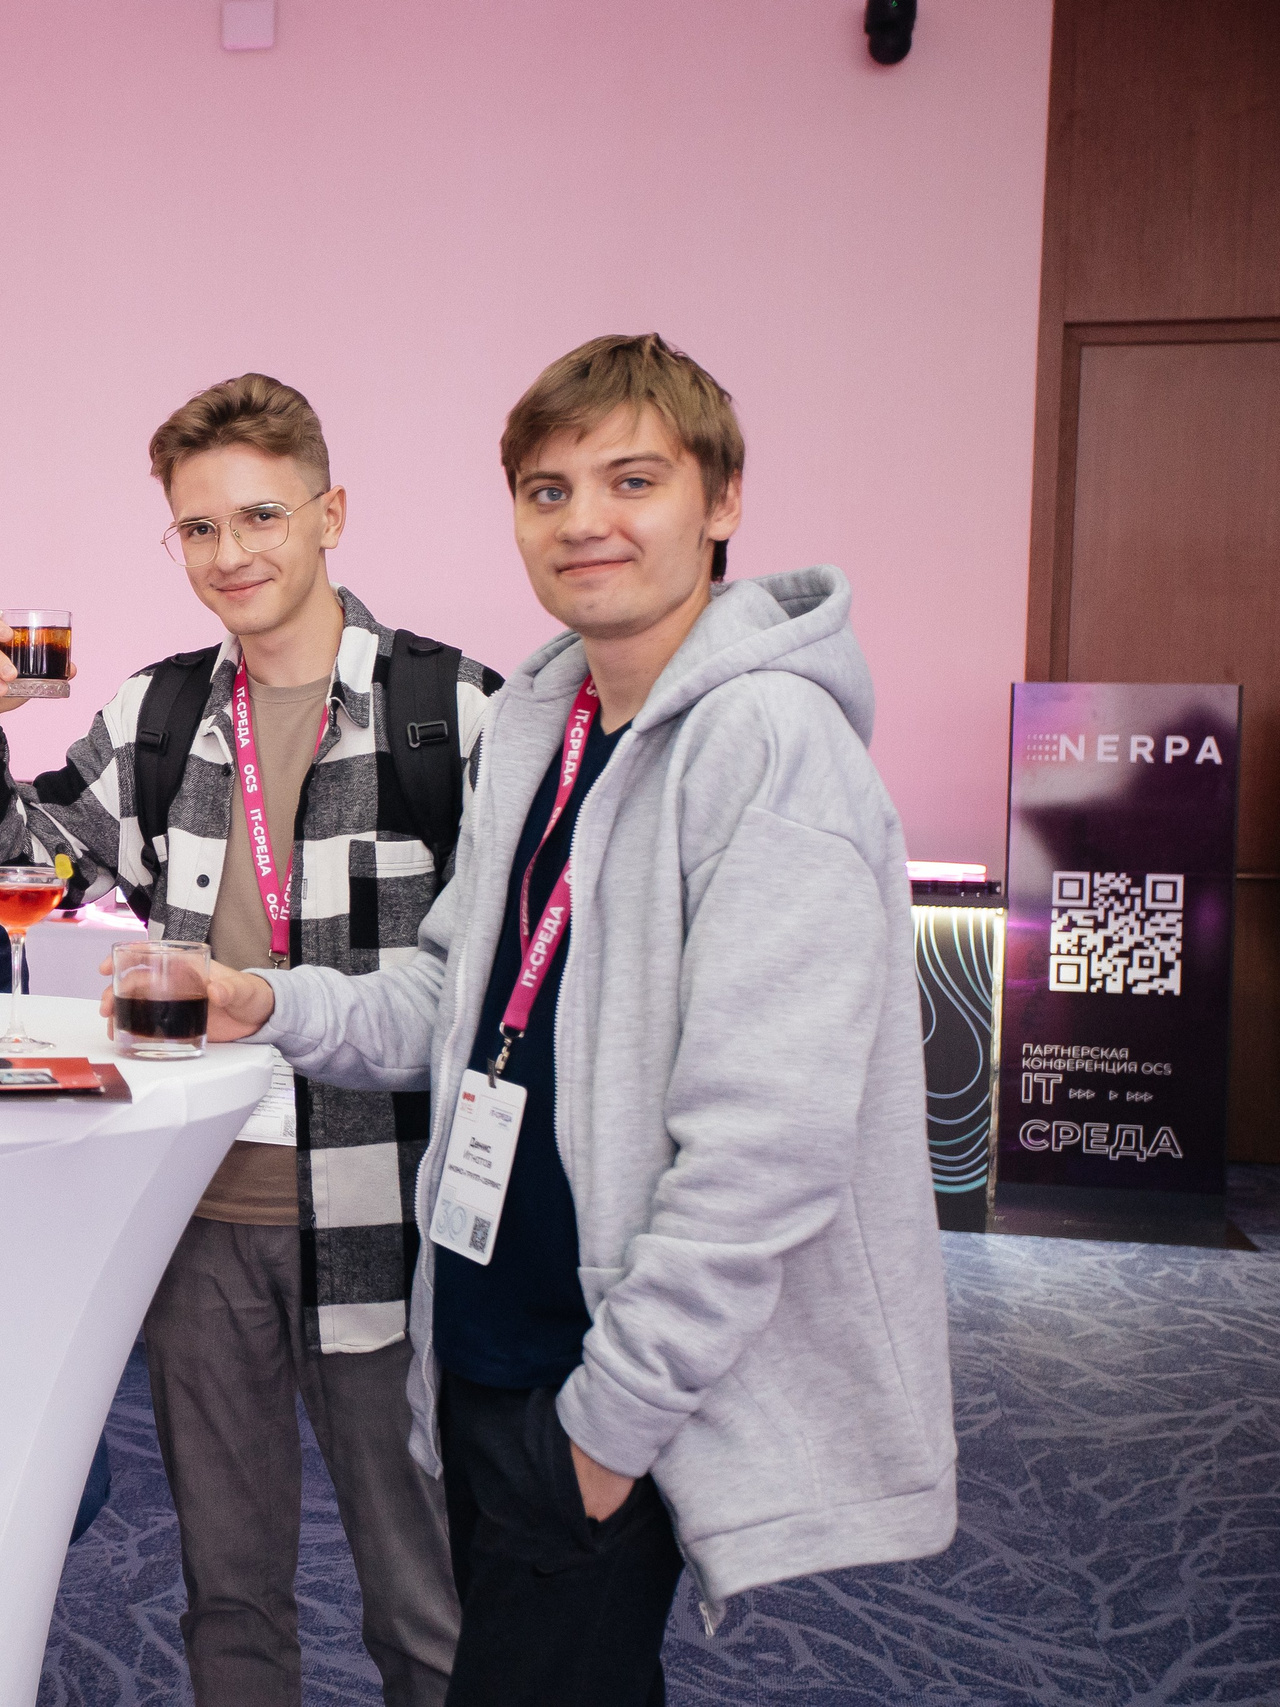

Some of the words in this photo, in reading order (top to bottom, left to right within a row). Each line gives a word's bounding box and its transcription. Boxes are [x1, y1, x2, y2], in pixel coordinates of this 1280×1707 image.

[236, 687, 251, 748] IT-СРЕДА
[563, 708, 590, 786] IT-СРЕДА
[1059, 734, 1223, 764] NERPA
[244, 764, 258, 793] OCS
[250, 808, 272, 876] IT-СРЕДА
[521, 906, 566, 988] IT-СРЕДА
[1022, 1043, 1129, 1060] ПАРТНЕРСКАЯ
[1022, 1057, 1138, 1075] КОНФЕРЕНЦИЯ
[1141, 1062, 1172, 1076] OCS
[1021, 1072, 1063, 1104] IT
[1019, 1119, 1183, 1162] СРЕДА
